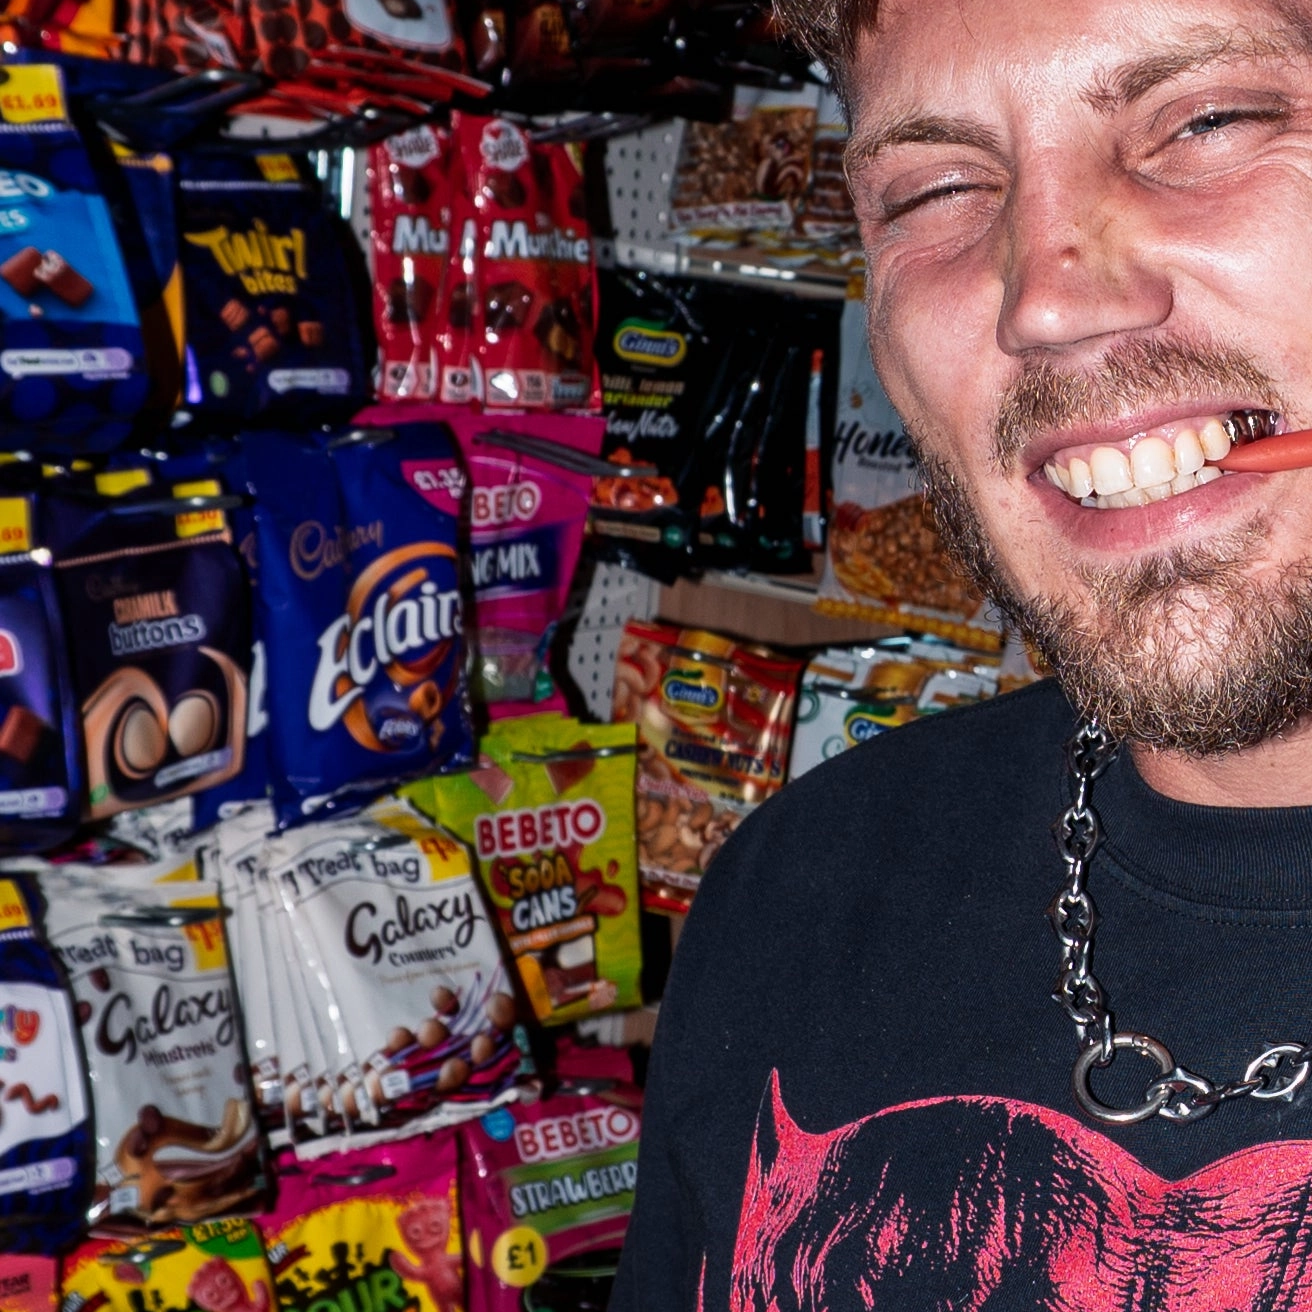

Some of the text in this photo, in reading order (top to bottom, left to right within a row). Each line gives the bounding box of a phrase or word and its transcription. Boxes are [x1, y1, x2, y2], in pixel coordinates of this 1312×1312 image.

[183, 217, 308, 279] Twirl
[474, 484, 537, 524] BETO
[498, 543, 541, 580] MIX
[110, 616, 206, 654] buttons
[476, 803, 601, 857] BEBETO
[297, 851, 420, 886] Treat bag
[508, 854, 574, 898] SODA
[345, 888, 486, 965] Galaxy
[511, 887, 577, 930] CANS
[129, 939, 185, 973] bag
[98, 989, 235, 1063] Galaxy
[518, 1109, 637, 1158] BEBETO
[506, 1241, 537, 1270] £1
